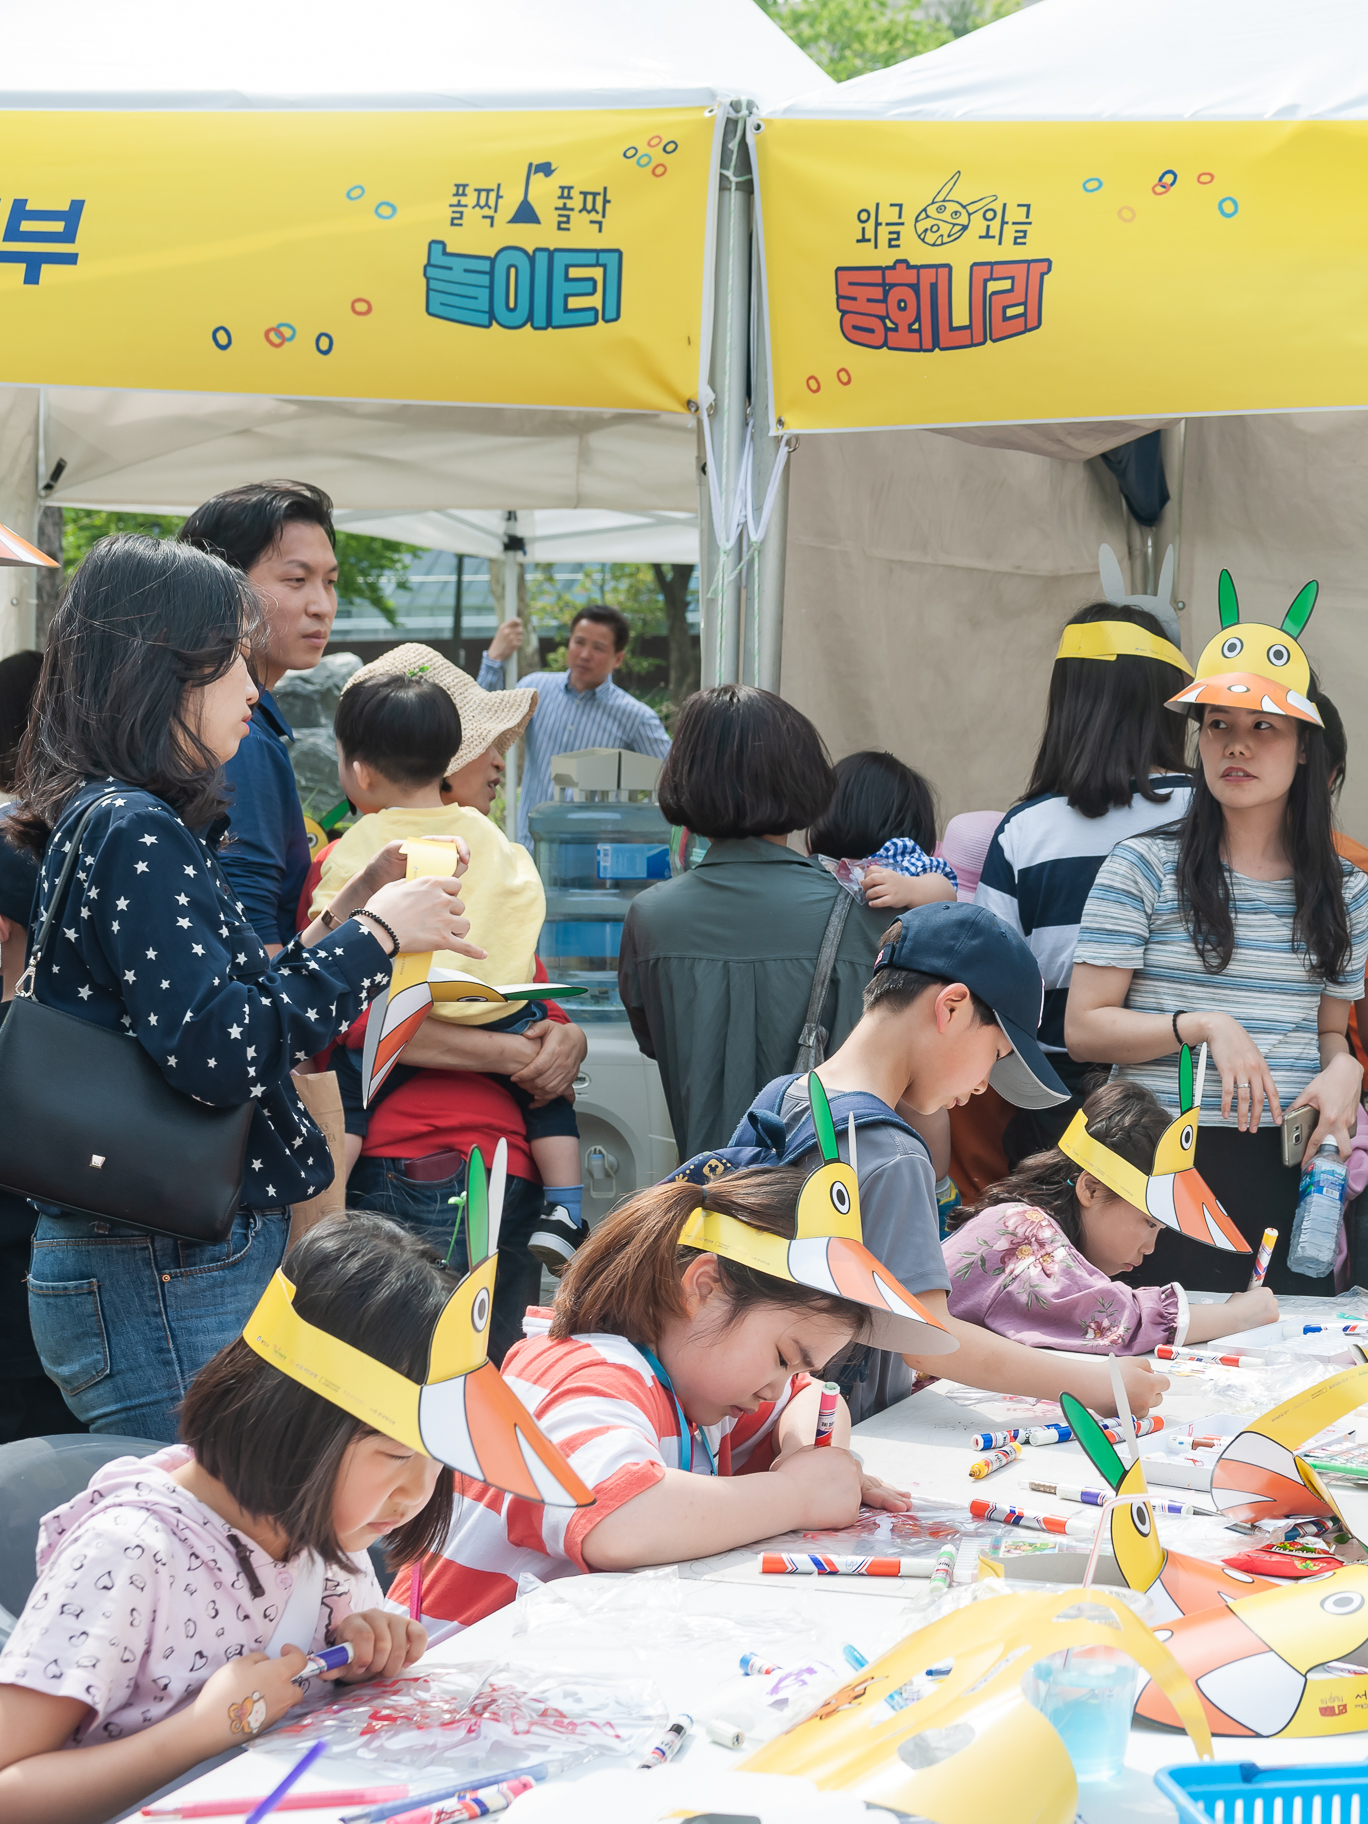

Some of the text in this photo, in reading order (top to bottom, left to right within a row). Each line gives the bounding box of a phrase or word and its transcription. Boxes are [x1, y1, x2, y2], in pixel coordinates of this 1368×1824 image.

[0, 198, 86, 286] 부
[448, 183, 612, 234] 폴짝 폴짝
[855, 202, 1033, 250] 와글 와글
[423, 239, 624, 331] 놀이터
[834, 258, 1053, 354] 동화나라
